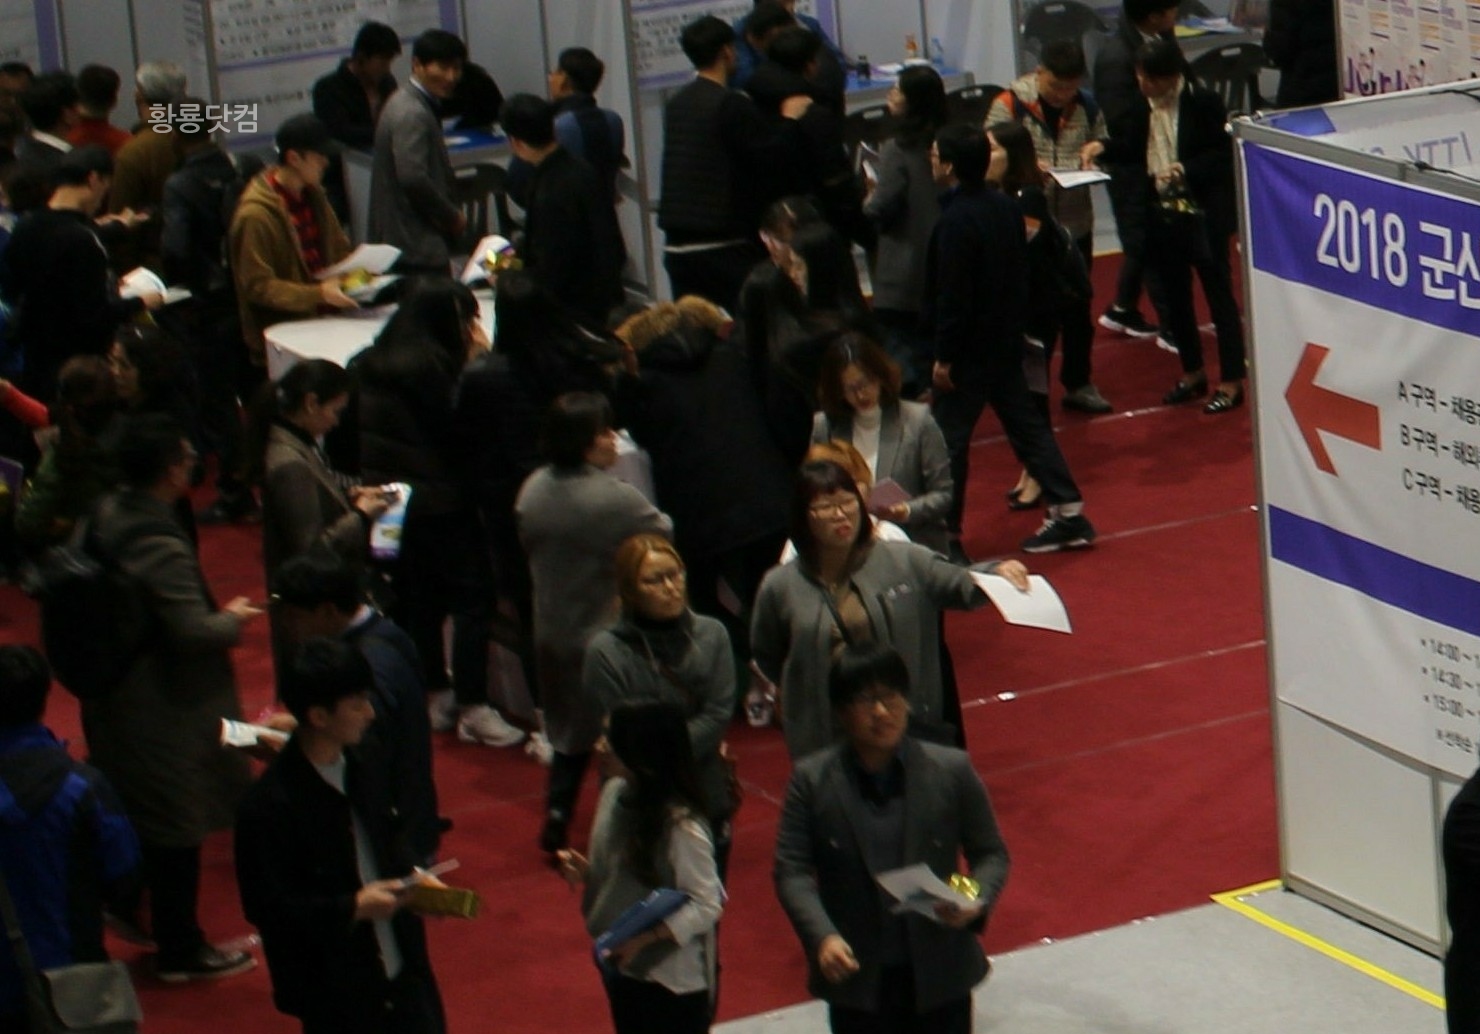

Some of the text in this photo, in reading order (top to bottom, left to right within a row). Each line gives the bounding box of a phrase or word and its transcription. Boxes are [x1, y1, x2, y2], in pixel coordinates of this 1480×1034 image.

[1313, 193, 1408, 287] 2018
[1398, 379, 1409, 402] A
[1411, 383, 1437, 412] 구역
[1400, 423, 1410, 446] B
[1412, 427, 1438, 457] 구역
[1403, 468, 1413, 490] C
[1415, 471, 1441, 501] 구역
